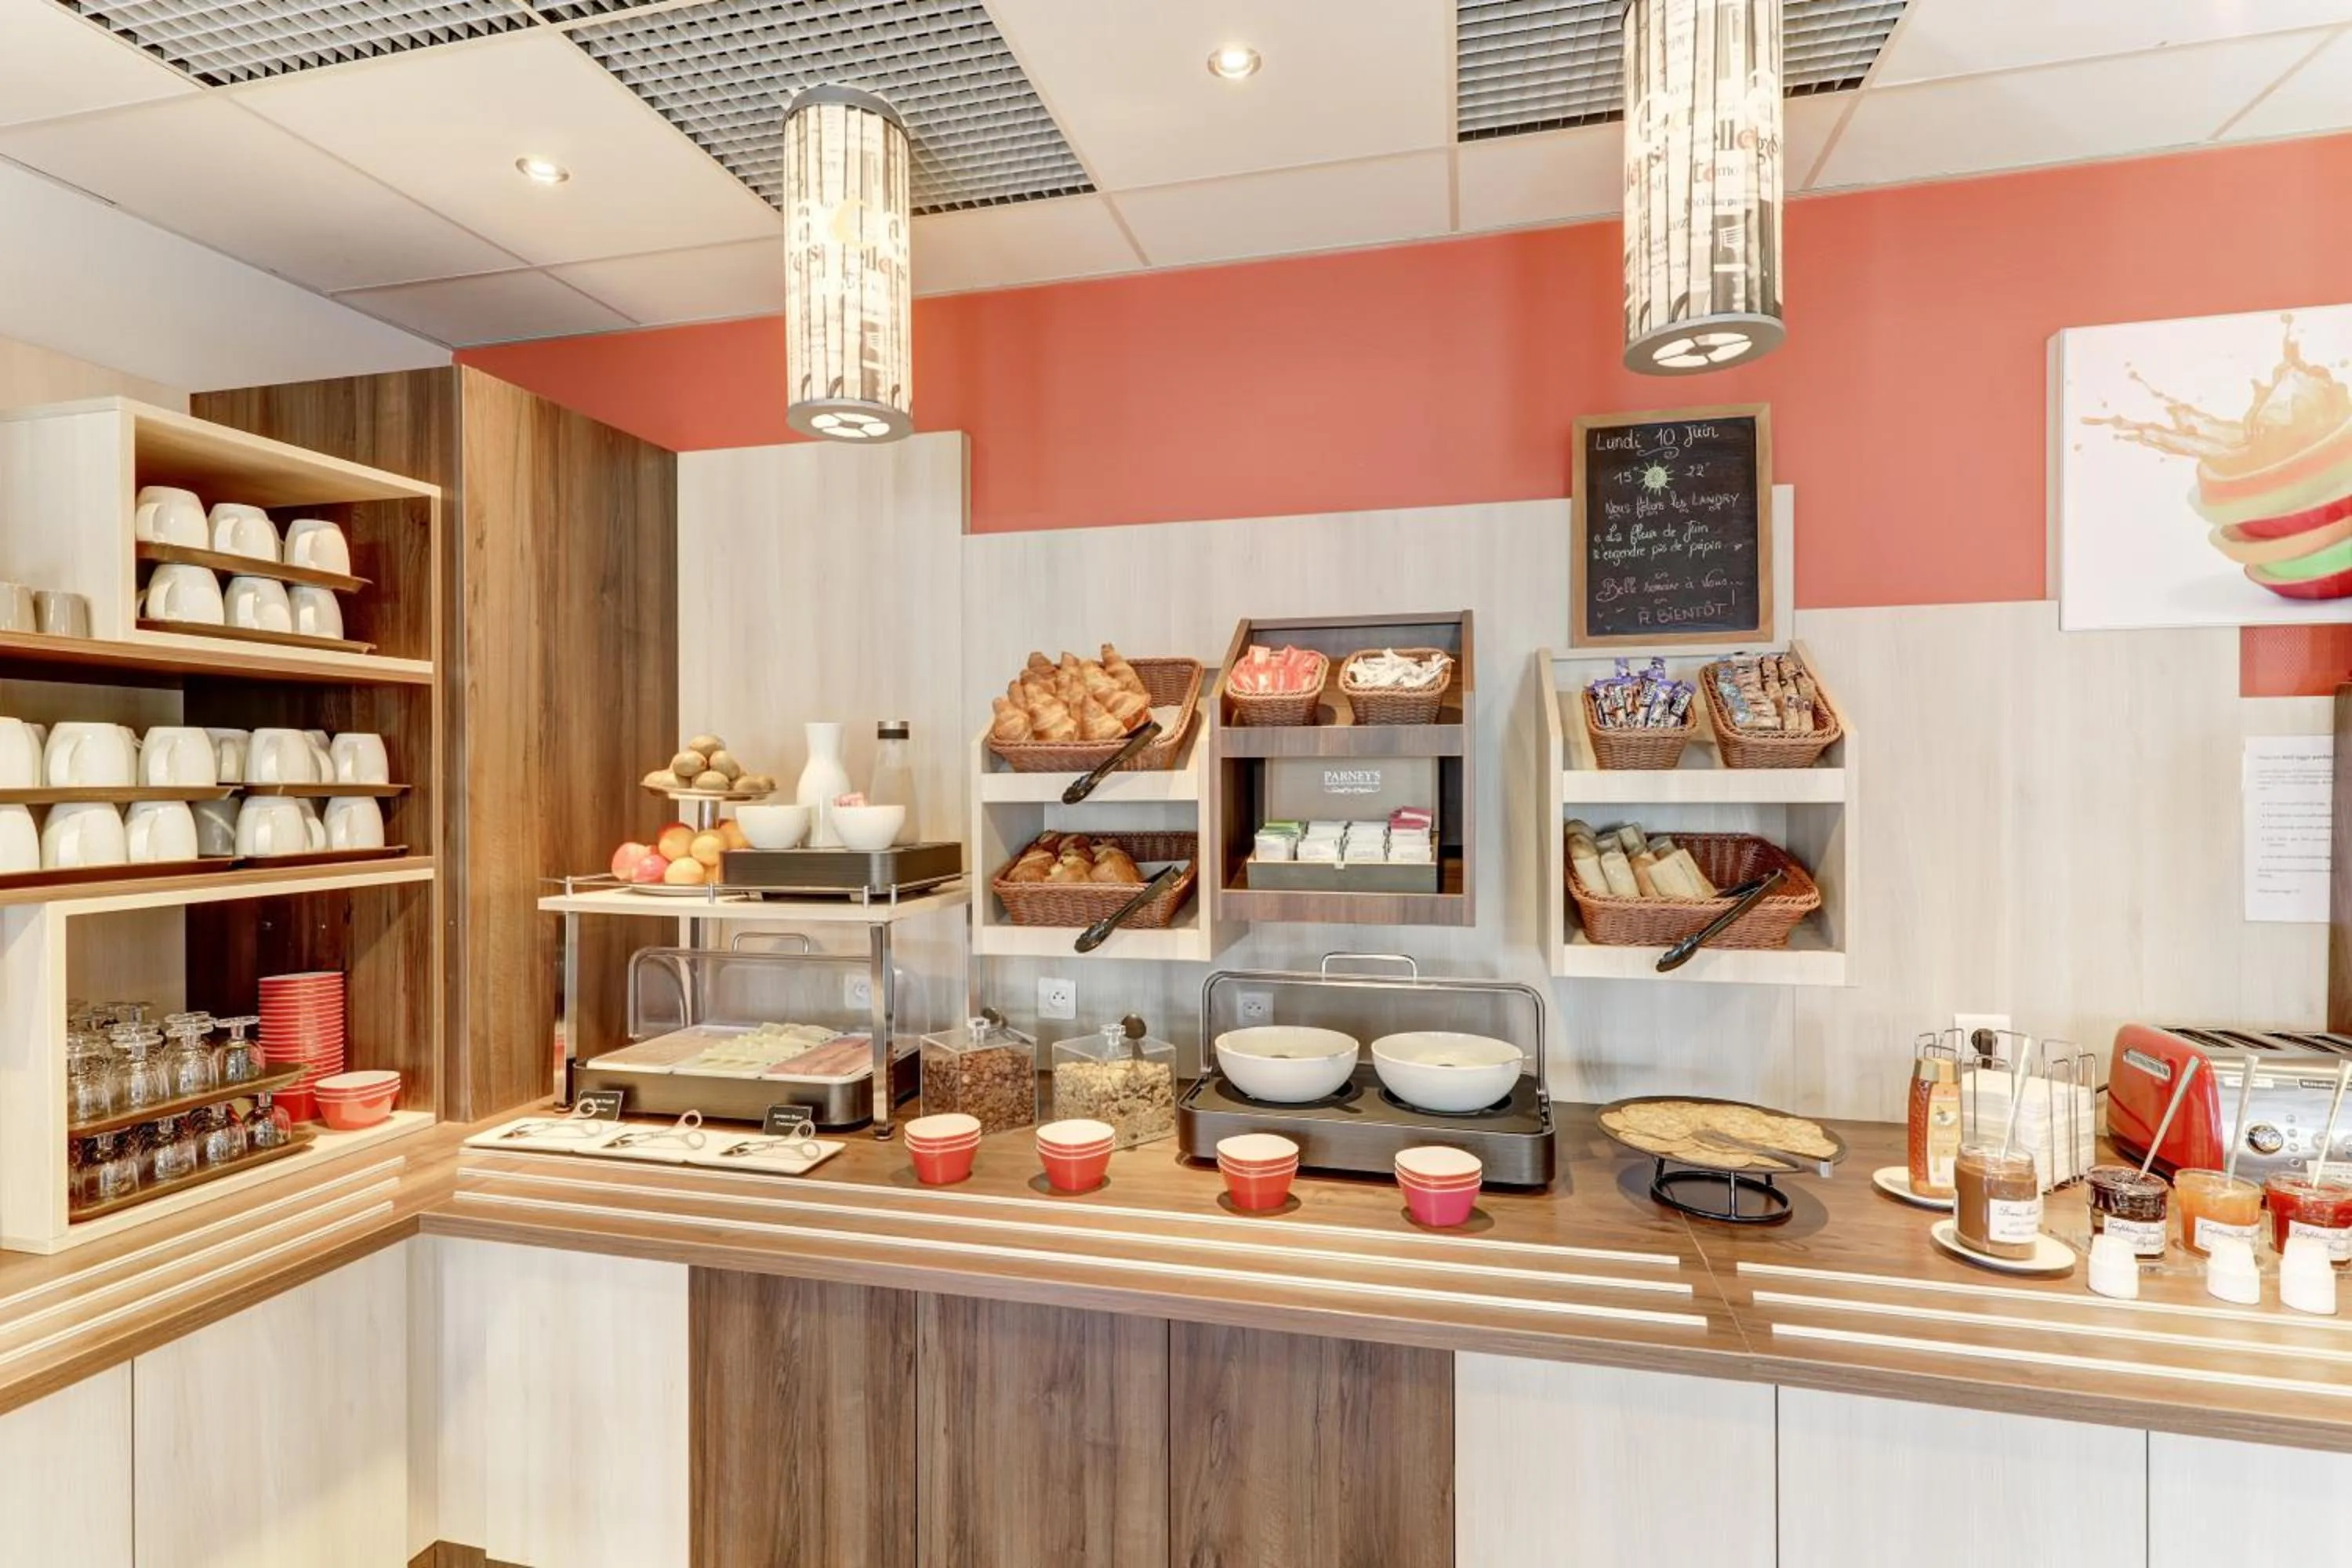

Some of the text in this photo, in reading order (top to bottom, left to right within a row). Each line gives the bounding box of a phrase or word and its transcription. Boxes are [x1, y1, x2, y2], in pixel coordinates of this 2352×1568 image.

[1596, 424, 1719, 451] Lundi 10 Juin
[1692, 492, 1740, 509] LANDRY
[1663, 524, 1676, 538] de
[1670, 542, 1682, 552] de
